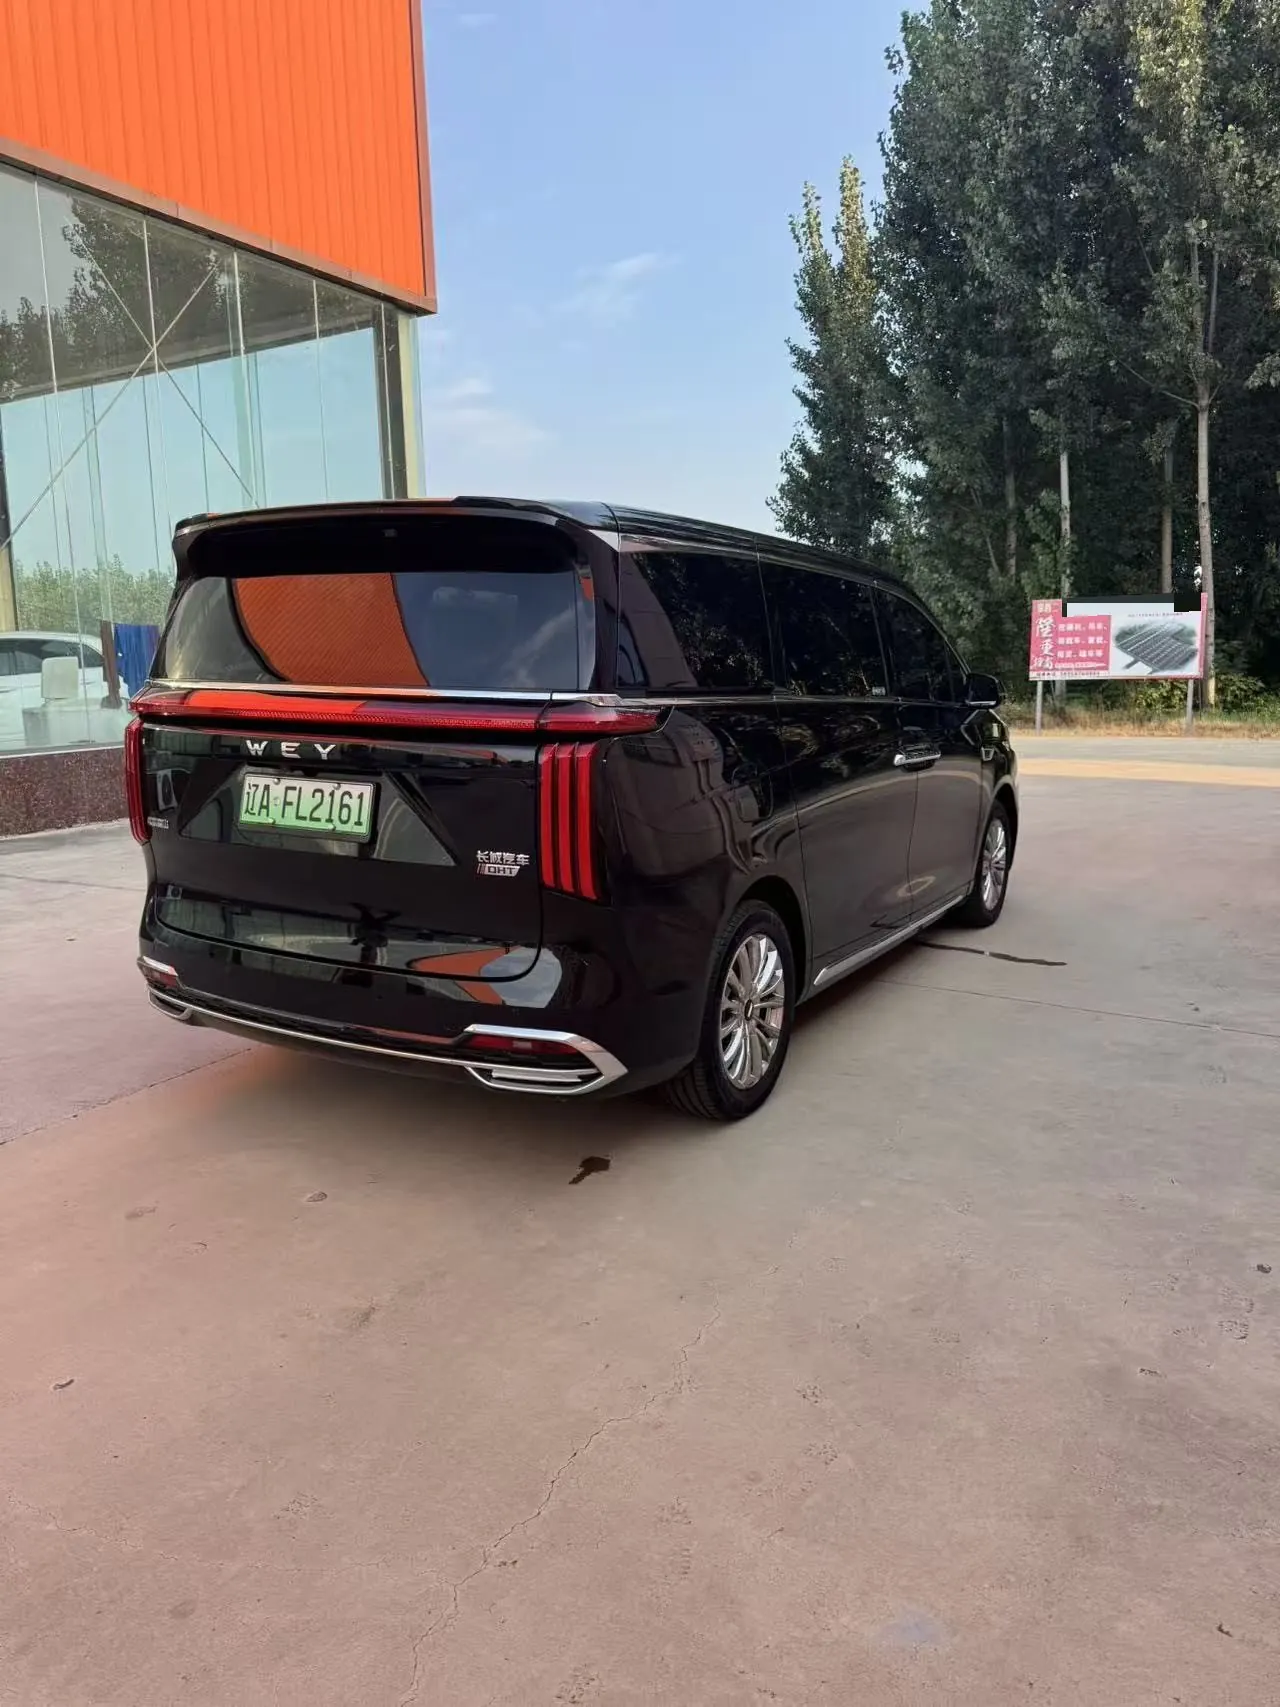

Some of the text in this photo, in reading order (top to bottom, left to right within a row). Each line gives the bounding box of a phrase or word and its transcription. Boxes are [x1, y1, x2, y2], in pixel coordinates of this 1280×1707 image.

[246, 739, 336, 760] WEY
[476, 850, 530, 866] 长城汽车
